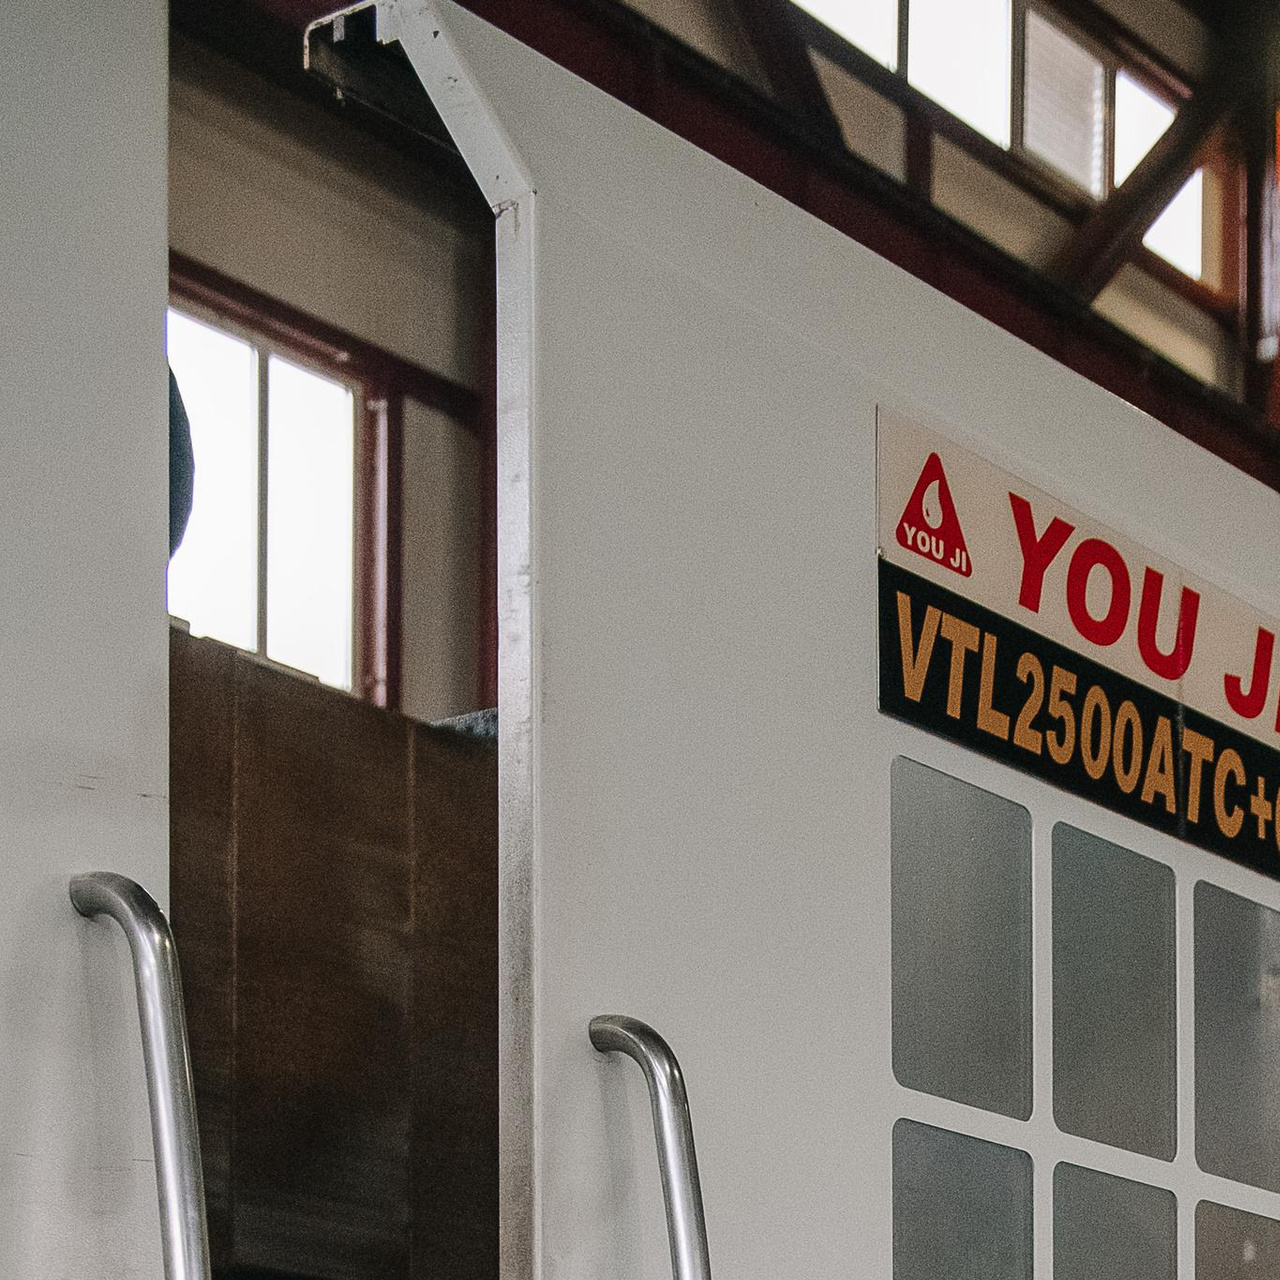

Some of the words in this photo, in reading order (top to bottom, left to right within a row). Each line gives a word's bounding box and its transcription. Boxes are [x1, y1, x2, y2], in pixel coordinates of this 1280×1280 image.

[903, 522, 944, 560] YOU
[950, 548, 967, 572] JI
[1008, 491, 1200, 681] YOU
